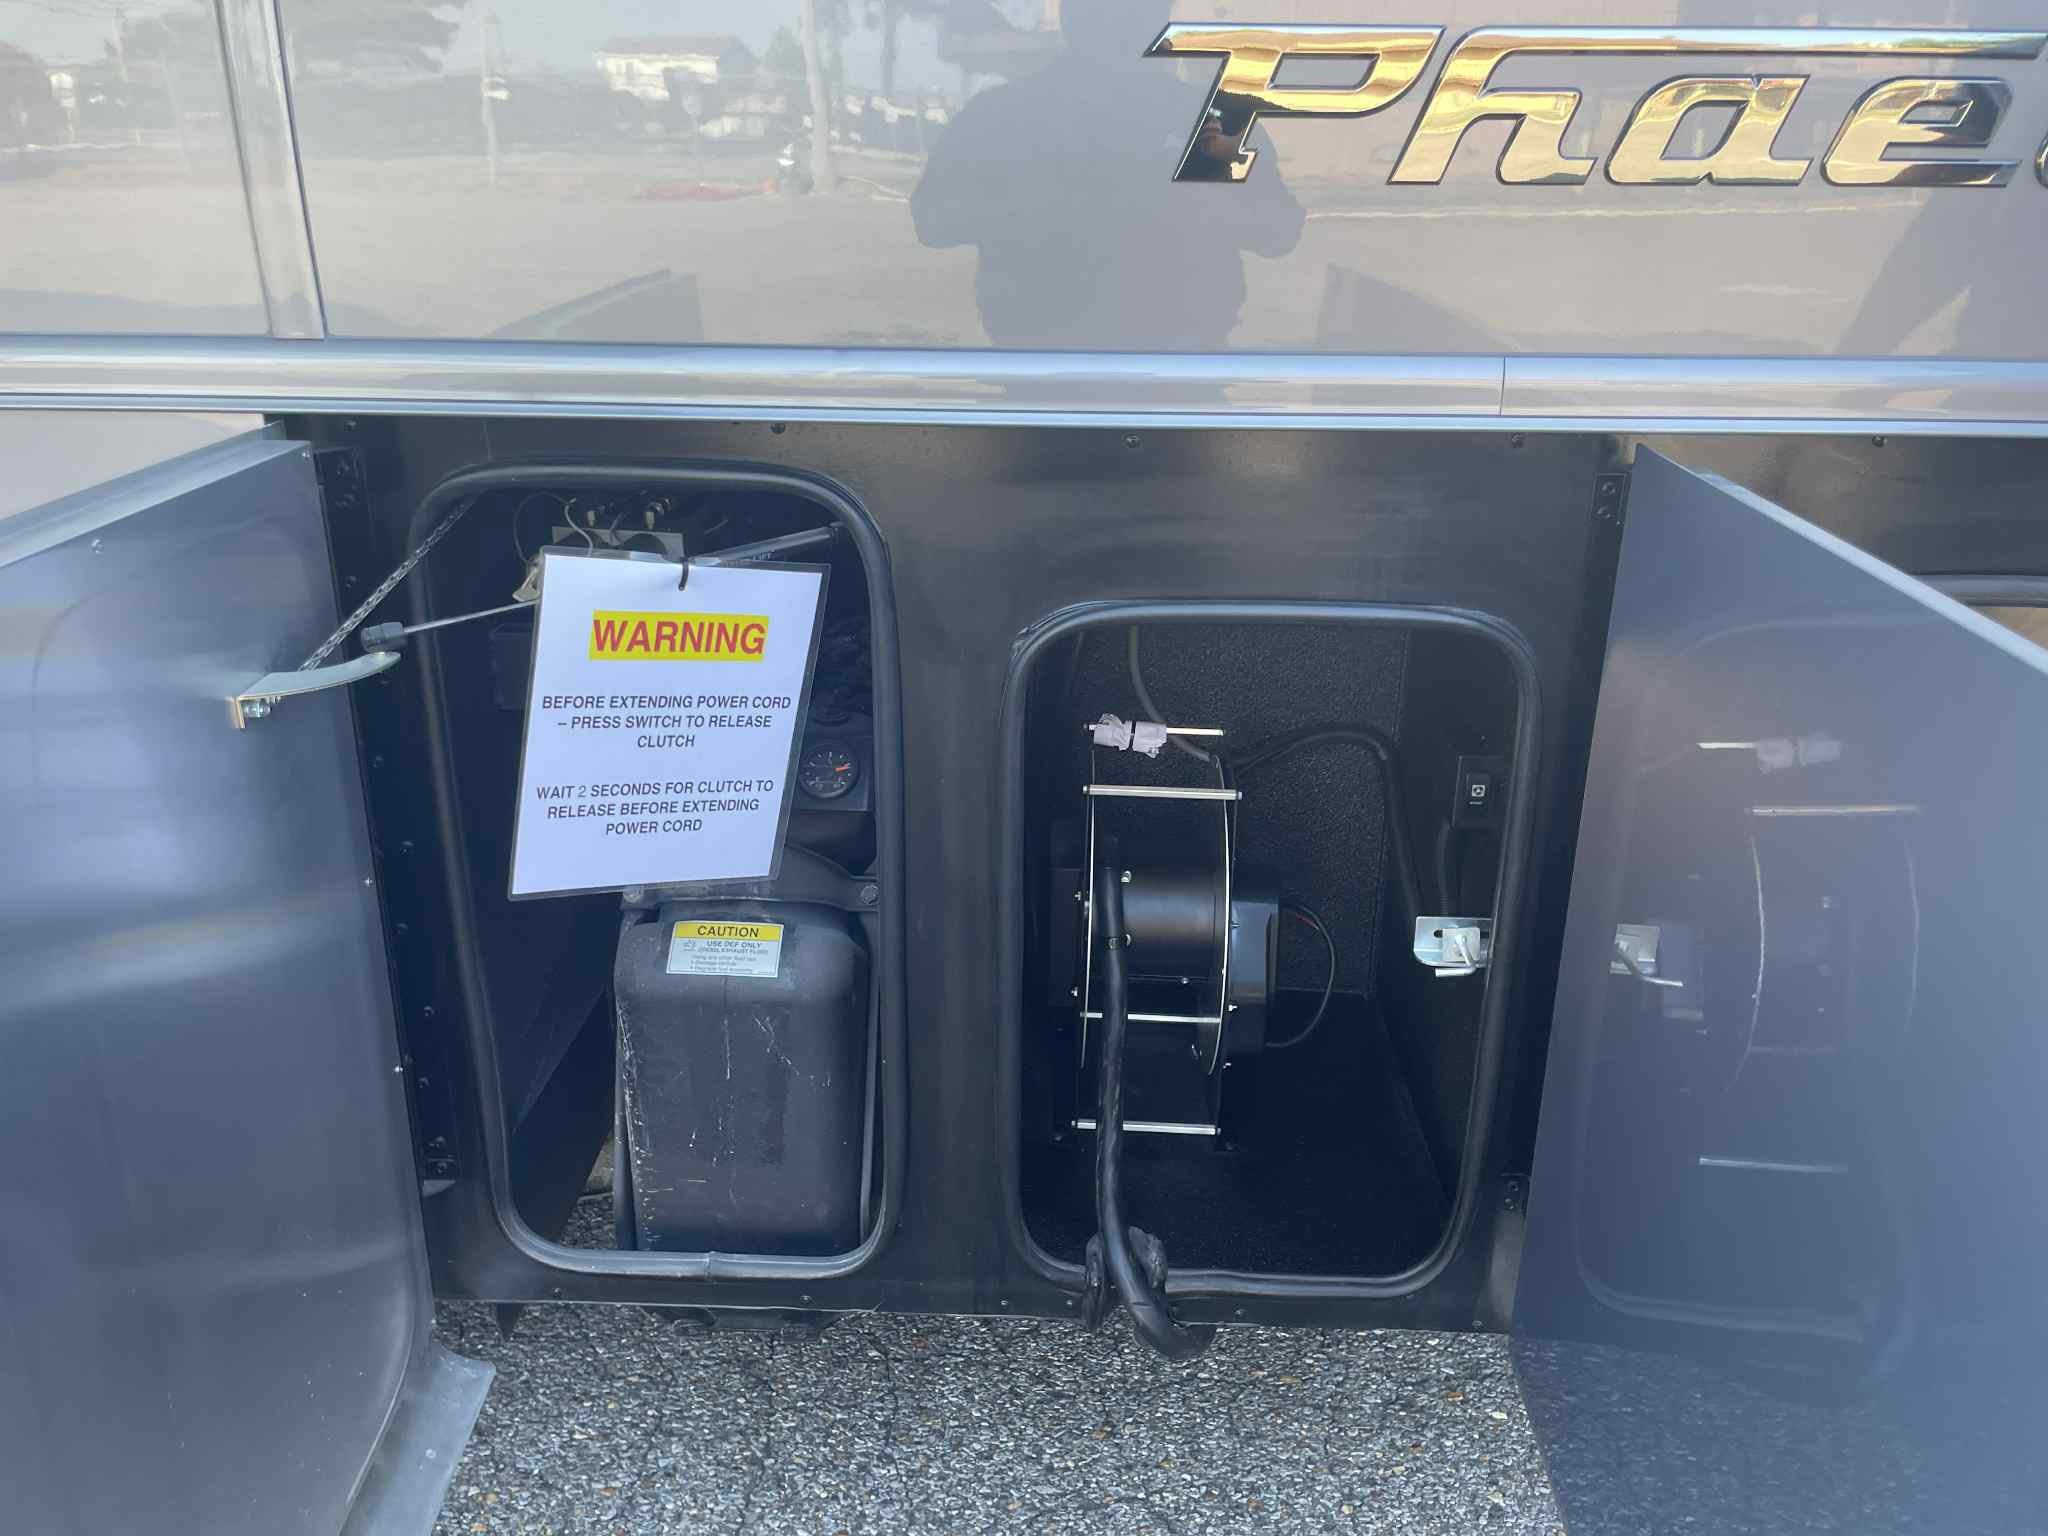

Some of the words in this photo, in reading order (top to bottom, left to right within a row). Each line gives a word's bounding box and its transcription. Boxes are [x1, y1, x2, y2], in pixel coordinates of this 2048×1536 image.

[1142, 23, 2048, 188] Phae
[592, 619, 768, 655] WARNING
[541, 695, 605, 709] BEFORE
[609, 695, 693, 709] EXTENDING
[696, 695, 749, 709] POWER
[752, 696, 792, 709] CORD
[570, 715, 622, 729] PRESS
[625, 715, 682, 729] SWITCH
[686, 715, 705, 728] TO
[708, 715, 772, 728] RELEASE
[637, 735, 695, 748] CLUTCH
[537, 785, 576, 800] WAIT
[577, 785, 587, 798] 2
[589, 783, 662, 798] SECONDS
[664, 781, 694, 795] FOR
[697, 780, 753, 794] CLUTCH
[756, 779, 774, 792] TO
[547, 803, 616, 819] RELEASE
[619, 801, 679, 816] BEFORE
[681, 798, 760, 813] EXTENDING
[605, 821, 659, 836] POWER
[662, 818, 703, 833] CORD
[697, 925, 760, 938] CAUTION
